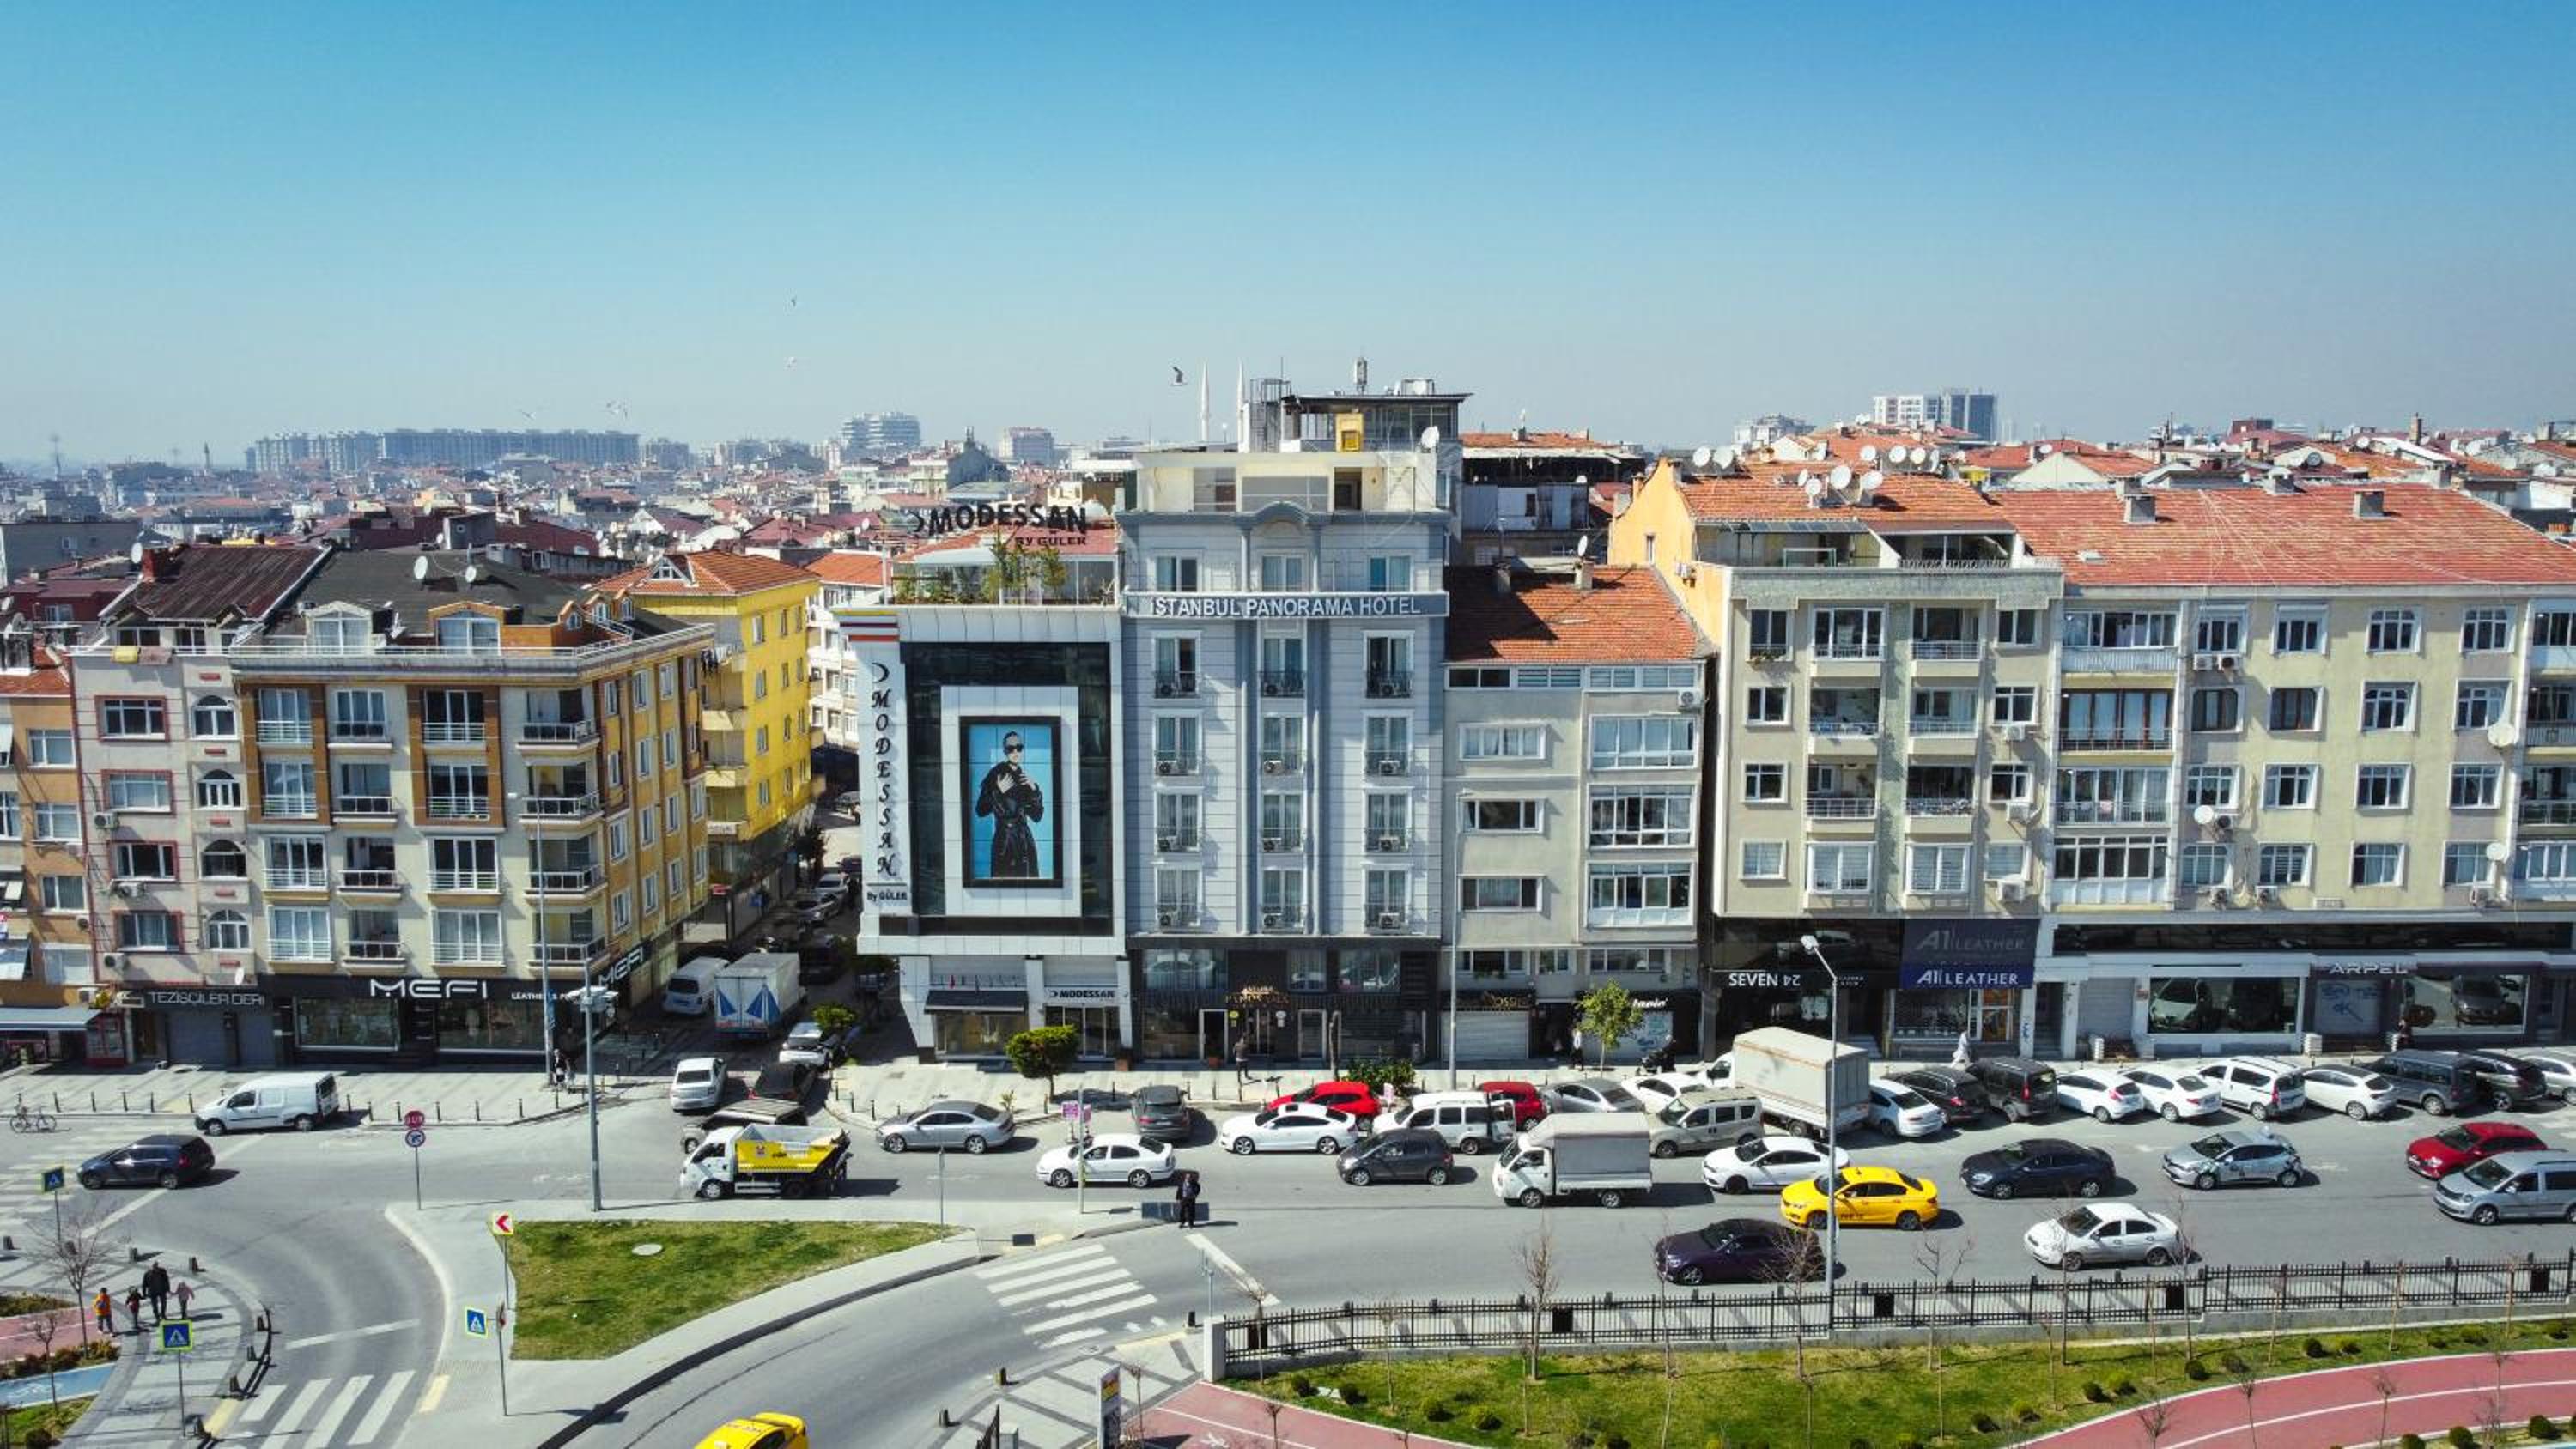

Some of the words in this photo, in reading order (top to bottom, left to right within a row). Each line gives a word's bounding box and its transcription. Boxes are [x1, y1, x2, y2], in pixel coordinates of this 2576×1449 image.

[928, 503, 1087, 536] MODESSAN
[1246, 597, 1354, 616] PANORAMA
[1359, 596, 1422, 615] HOTEL
[2329, 961, 2409, 974] ARPEL
[1728, 973, 1778, 986] SEVEN
[1945, 973, 2019, 985] LEATHER
[369, 979, 488, 998] MEFI
[1059, 990, 1115, 998] MODESSAN
[511, 991, 547, 1000] LEATHE
